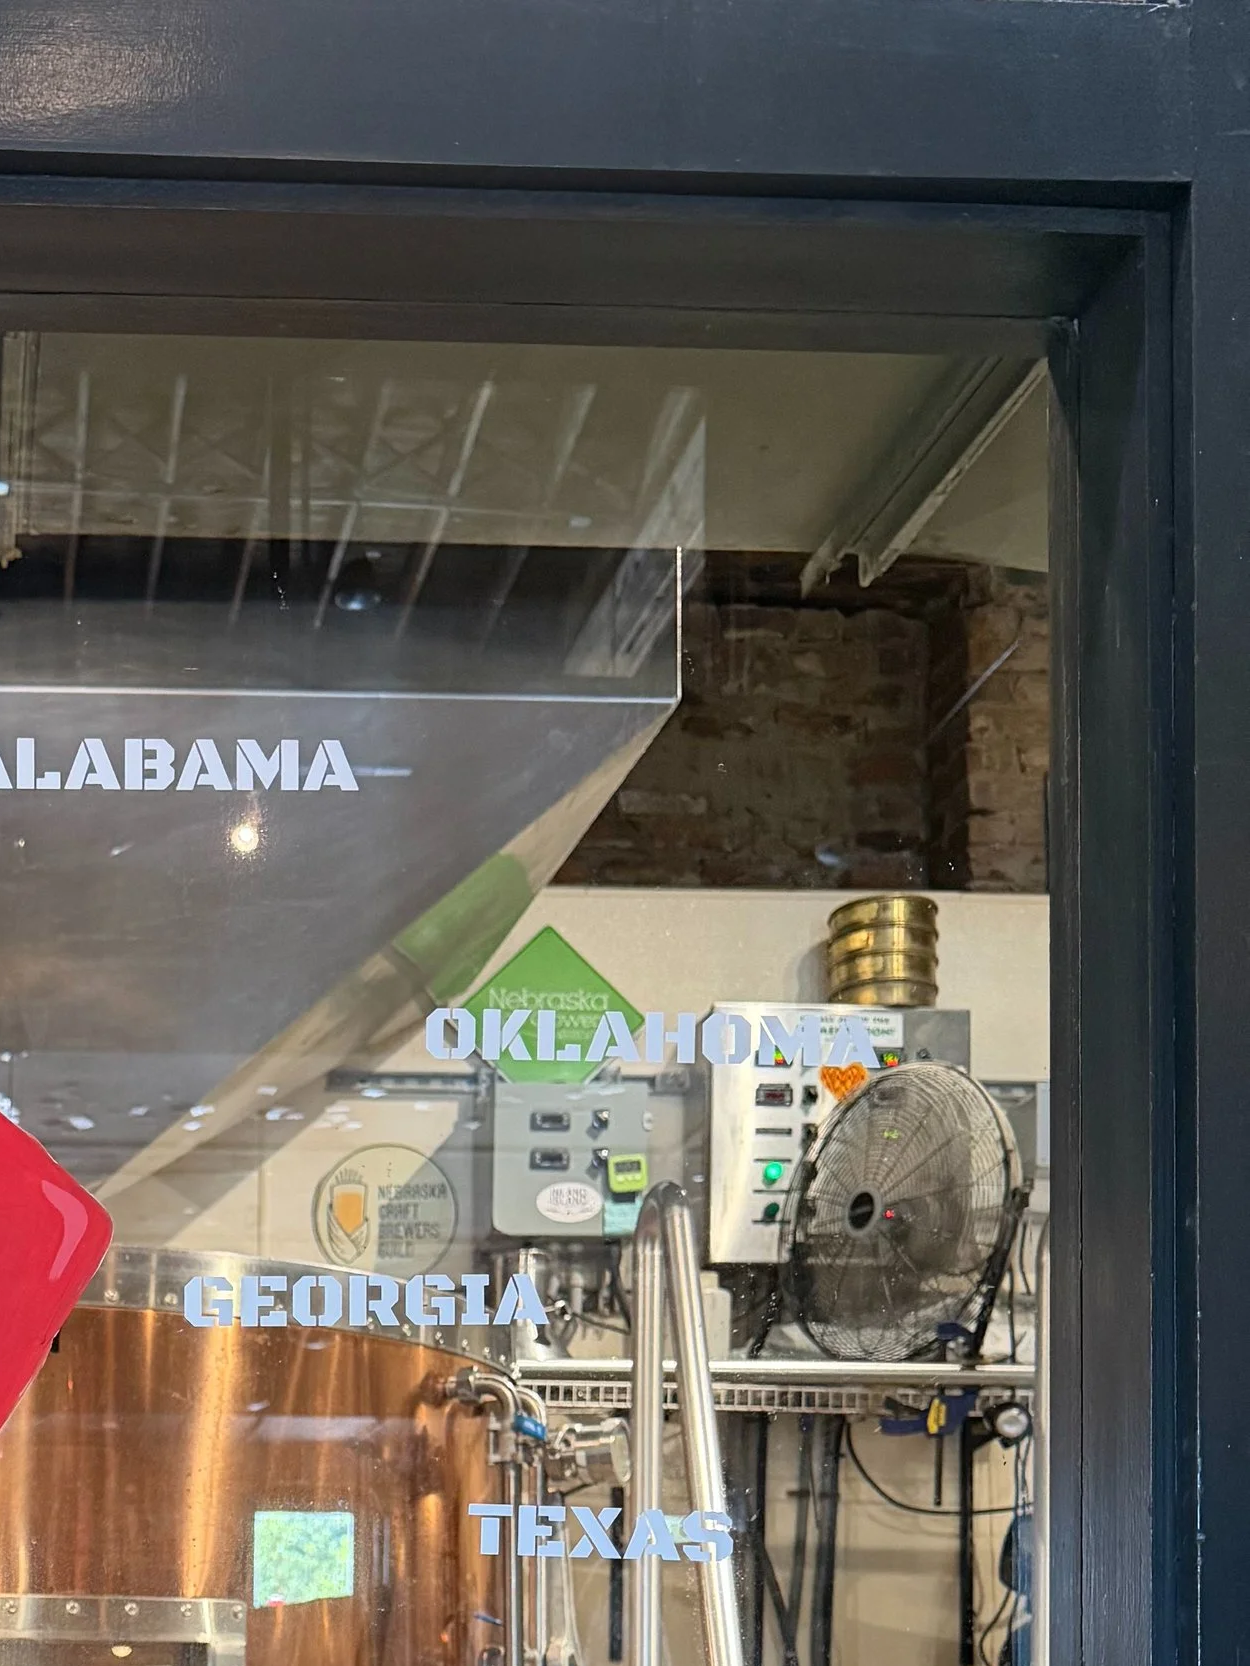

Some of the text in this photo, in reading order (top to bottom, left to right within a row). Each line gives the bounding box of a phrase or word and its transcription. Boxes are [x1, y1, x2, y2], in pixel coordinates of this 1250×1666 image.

[489, 987, 610, 1010] Nebraska
[425, 1007, 882, 1068] OKLAHOMA
[377, 1183, 448, 1200] NEBRASKA
[377, 1202, 419, 1220] CRAFT
[377, 1221, 441, 1240] BREWERS
[183, 1273, 550, 1328] GEORGIA
[468, 1503, 734, 1563] TEXAS
